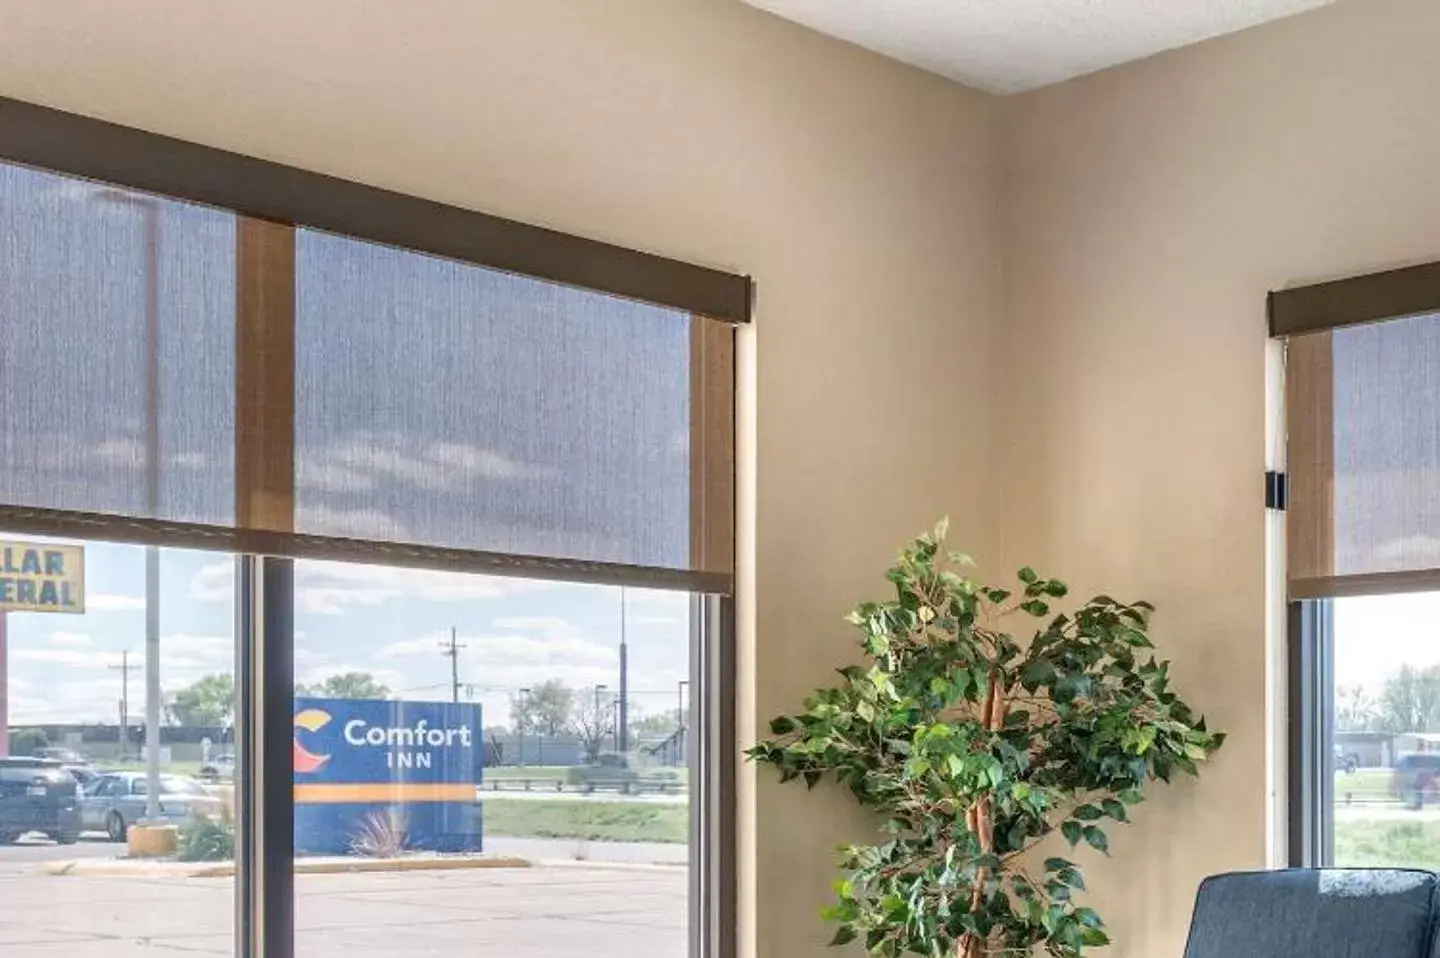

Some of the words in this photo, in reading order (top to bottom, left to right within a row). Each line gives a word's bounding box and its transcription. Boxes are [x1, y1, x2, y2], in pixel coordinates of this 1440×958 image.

[0, 547, 65, 576] LAR
[344, 719, 472, 747] Comfort
[386, 752, 431, 769] INN
